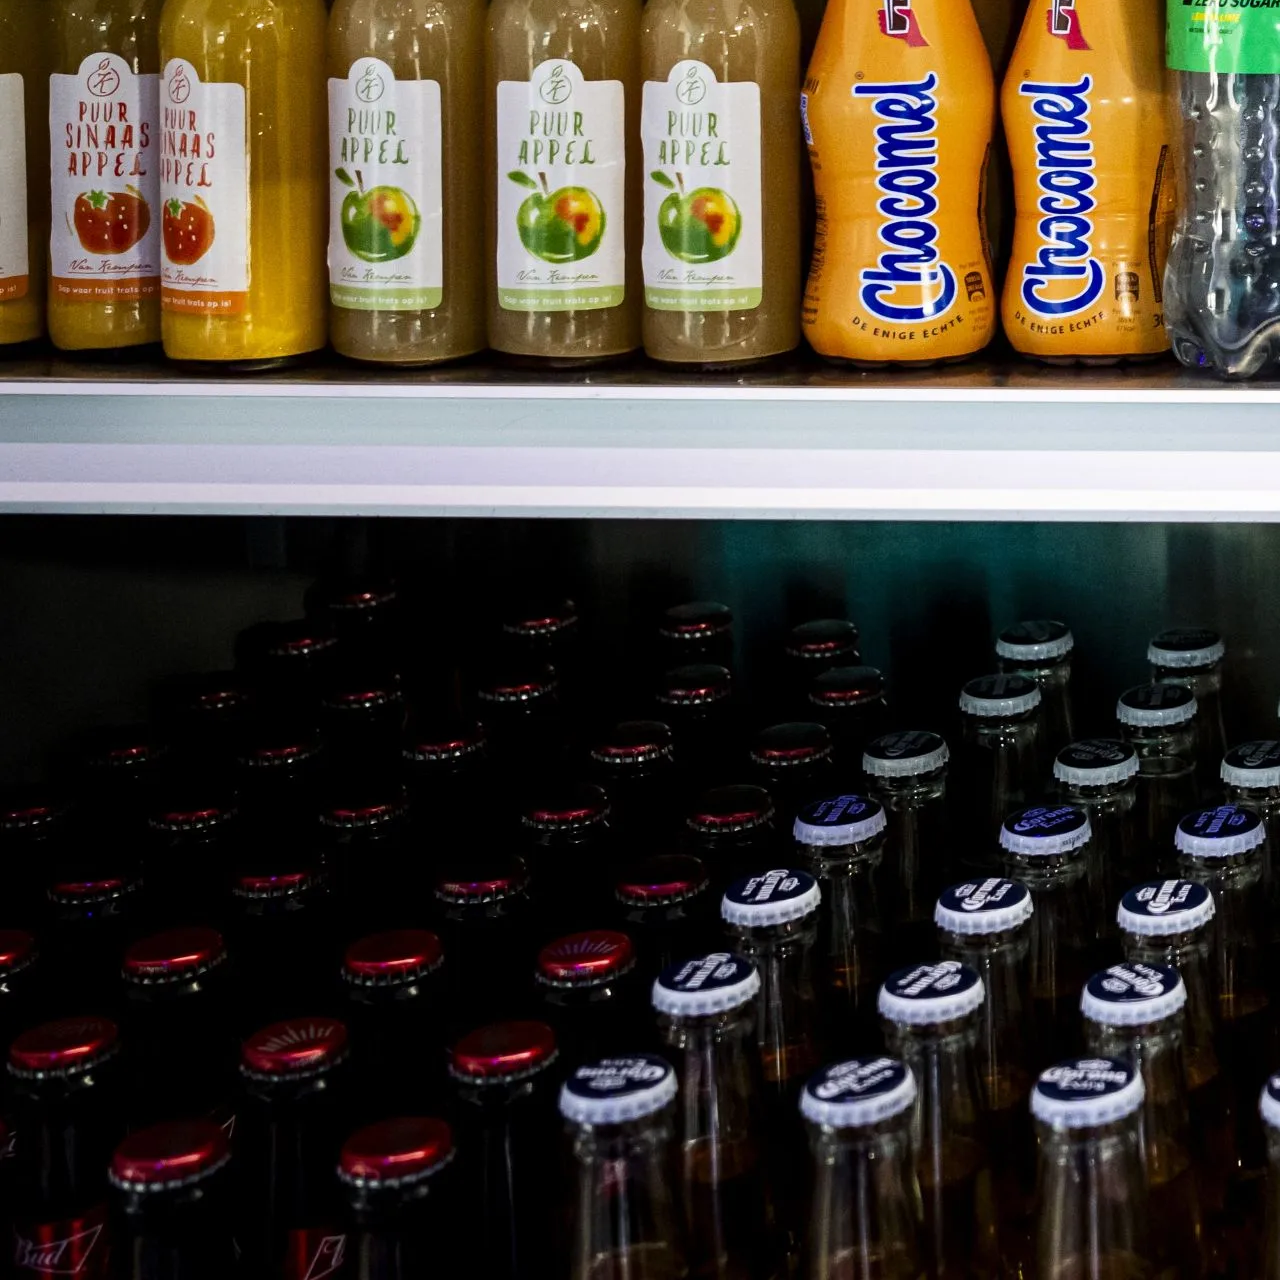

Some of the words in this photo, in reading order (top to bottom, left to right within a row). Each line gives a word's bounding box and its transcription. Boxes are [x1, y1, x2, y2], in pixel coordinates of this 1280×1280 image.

[78, 101, 128, 123] PUUR
[347, 106, 397, 136] PUUR
[529, 109, 584, 138] PUUR
[667, 110, 718, 139] PUUR
[65, 122, 149, 149] SINAAS
[67, 151, 148, 178] APPEL
[340, 136, 409, 165] APPEL
[517, 138, 596, 166] APPEL
[657, 139, 731, 167] APPEL
[851, 70, 958, 324] Chocomel
[1018, 72, 1107, 319] Chocomel
[852, 316, 867, 332] DE
[873, 328, 915, 340] ENIGE
[1030, 324, 1065, 335] ENIGE
[1014, 805, 1074, 832] Corona
[1147, 879, 1179, 914] Corona
